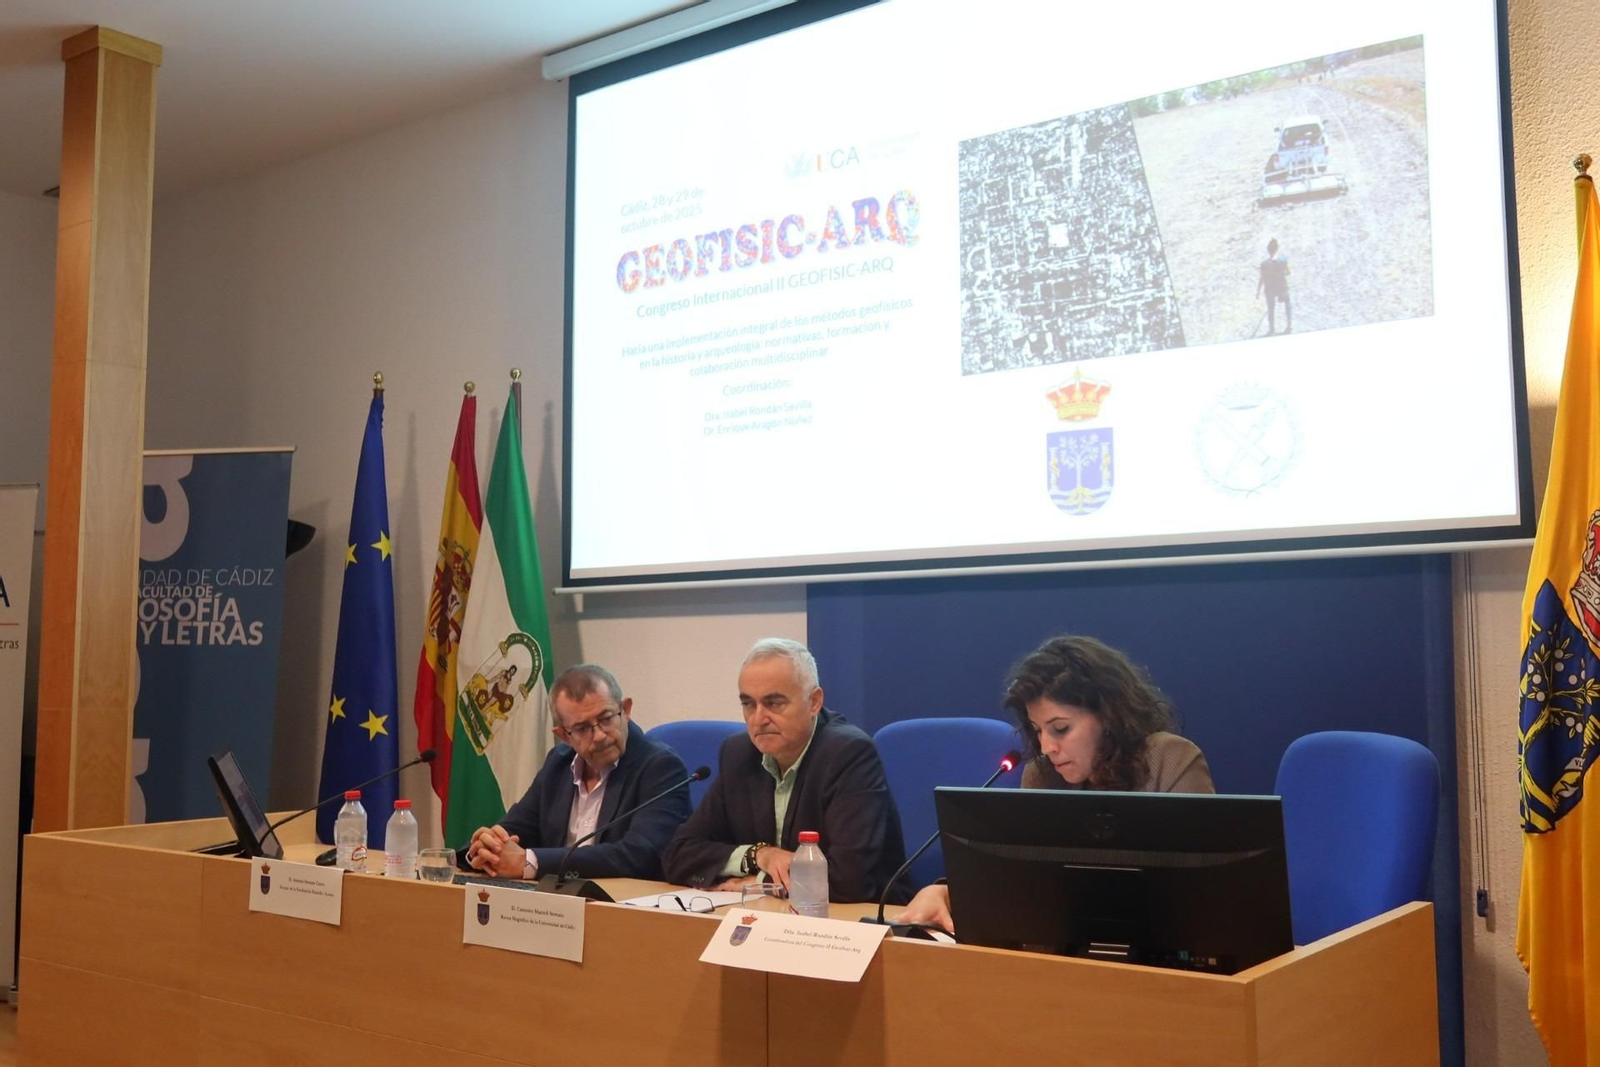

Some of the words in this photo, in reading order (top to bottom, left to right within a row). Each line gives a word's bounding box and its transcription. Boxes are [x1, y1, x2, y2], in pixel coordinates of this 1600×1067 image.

[651, 195, 665, 208] 28
[690, 187, 705, 198] de
[620, 216, 659, 234] octubre
[660, 211, 673, 223] de
[616, 189, 921, 294] GEOFISIC-ARQ
[636, 298, 690, 318] Congreso
[692, 279, 774, 307] Internacional
[776, 277, 785, 291] II
[787, 256, 894, 288] GEOFISIC-ARQ
[622, 343, 647, 357] Hacia
[647, 342, 664, 354] una
[665, 328, 739, 350] implementación
[740, 319, 778, 336] integral
[780, 318, 793, 329] de
[794, 315, 808, 326] los
[810, 305, 857, 324] métodos
[640, 360, 651, 370] en
[651, 355, 660, 367] la
[661, 350, 696, 366] historia
[826, 318, 881, 339] formación
[882, 319, 892, 331] y
[689, 357, 750, 376] colaboración
[750, 346, 828, 369] multidisciplinar
[783, 400, 813, 412] Sevilla
[716, 421, 749, 435] Enrique
[186, 569, 213, 586] DE
[215, 565, 274, 586] CÁDIZ
[138, 585, 193, 599] ACULTAD
[194, 585, 214, 599] DE
[138, 592, 242, 623] OSOFÍA
[140, 620, 158, 645] Y
[160, 620, 265, 646] LETRAS
